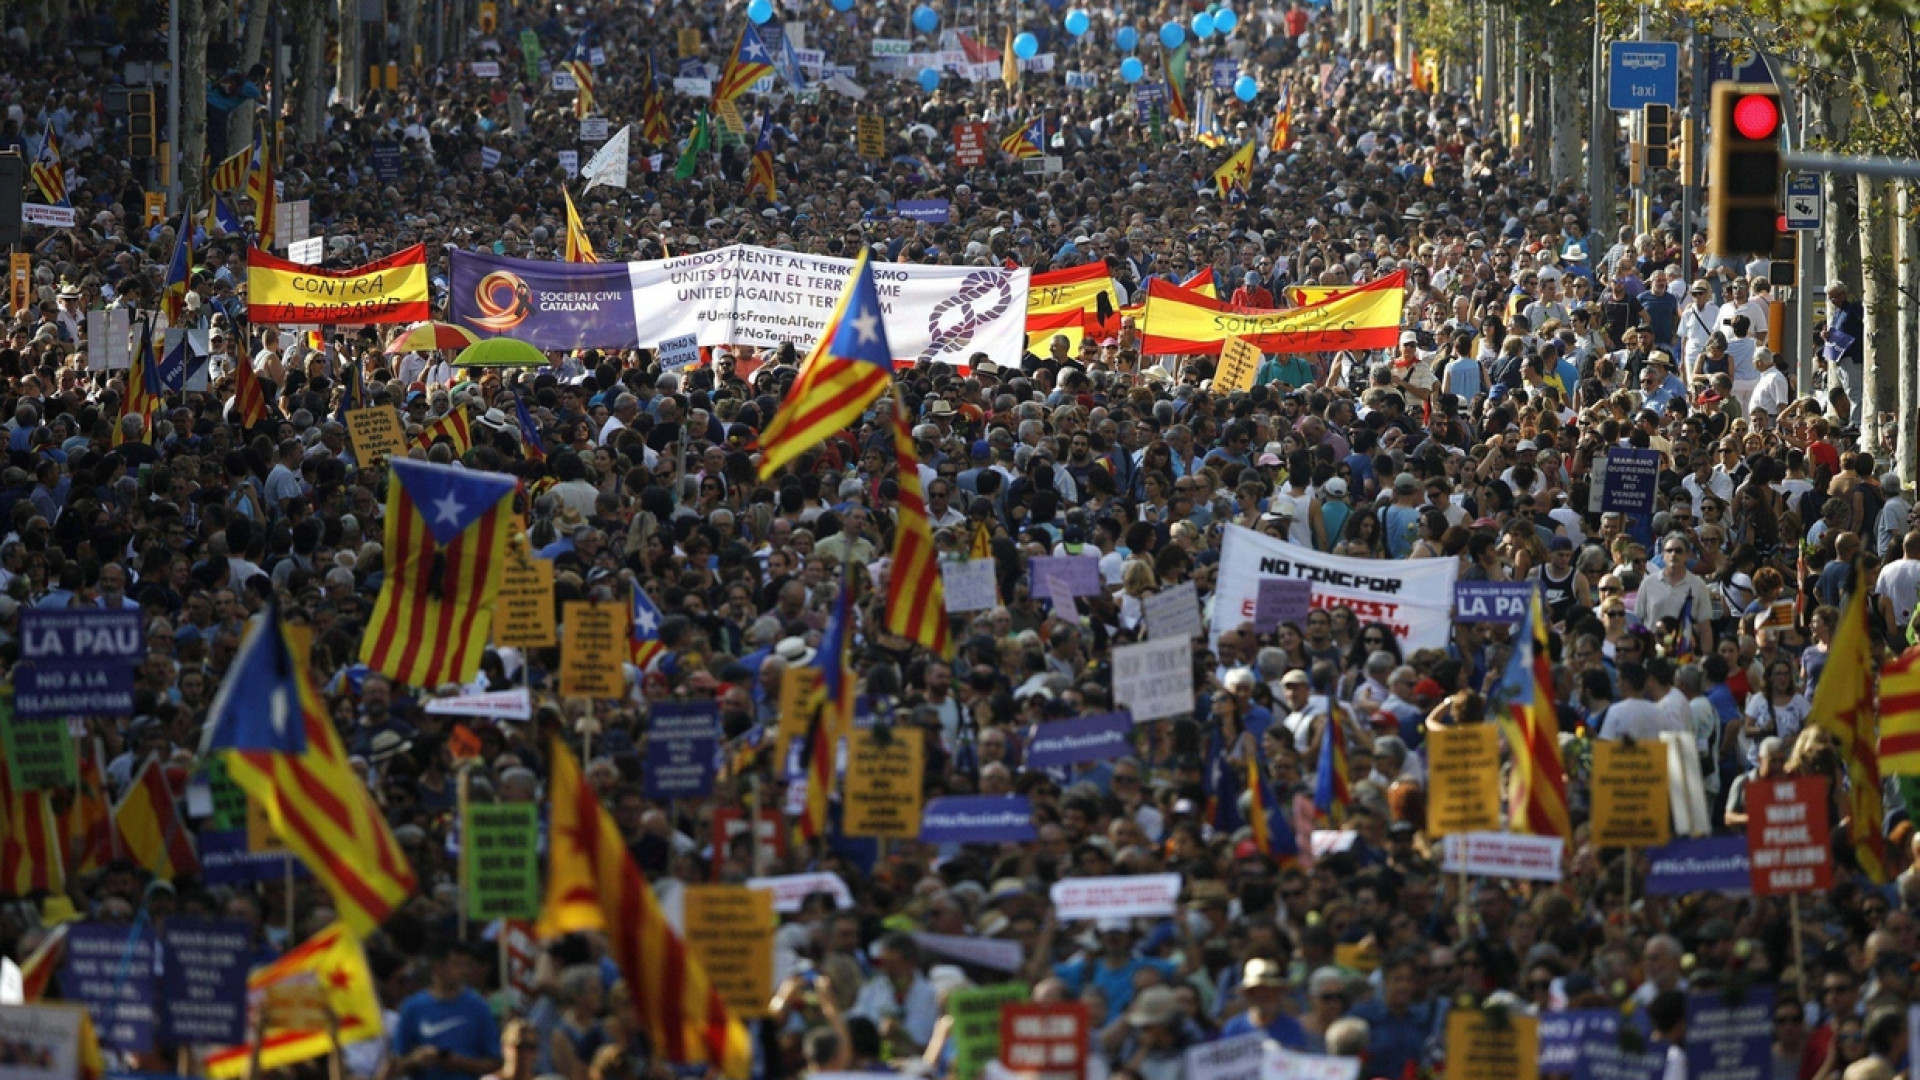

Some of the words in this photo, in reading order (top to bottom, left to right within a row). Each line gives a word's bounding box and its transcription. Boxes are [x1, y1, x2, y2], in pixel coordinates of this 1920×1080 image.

[1632, 83, 1656, 97] taxi
[664, 252, 724, 270] UNIDOS
[730, 250, 783, 268] FRENTE
[788, 258, 806, 270] AL
[812, 262, 909, 281] TERROSMO
[292, 274, 384, 297] CONTRA
[671, 270, 716, 285] UNITS
[786, 274, 802, 287] EL
[540, 291, 592, 302] SOCIETAT
[595, 291, 623, 302] CIVIL
[678, 287, 732, 302] UNITED
[734, 287, 803, 306] AGAINST
[540, 302, 600, 311] CATALANA
[734, 327, 818, 345] #NoTenimPo
[1608, 466, 1656, 476] QUEREMOS
[1612, 457, 1654, 466] MARIANO
[1611, 490, 1646, 499] VENDER
[1260, 556, 1291, 576] NO
[1294, 562, 1352, 587] TINC
[1354, 574, 1402, 594] POR
[1458, 596, 1489, 616] LA
[1494, 596, 1526, 616] PA
[22, 628, 64, 656] LA
[74, 627, 140, 656] PAU
[36, 671, 65, 689] NO
[69, 671, 82, 688] A
[86, 670, 108, 687] LA
[1032, 729, 1123, 752] #NoTenimPo
[1651, 855, 1750, 876] #NoTenimPo
